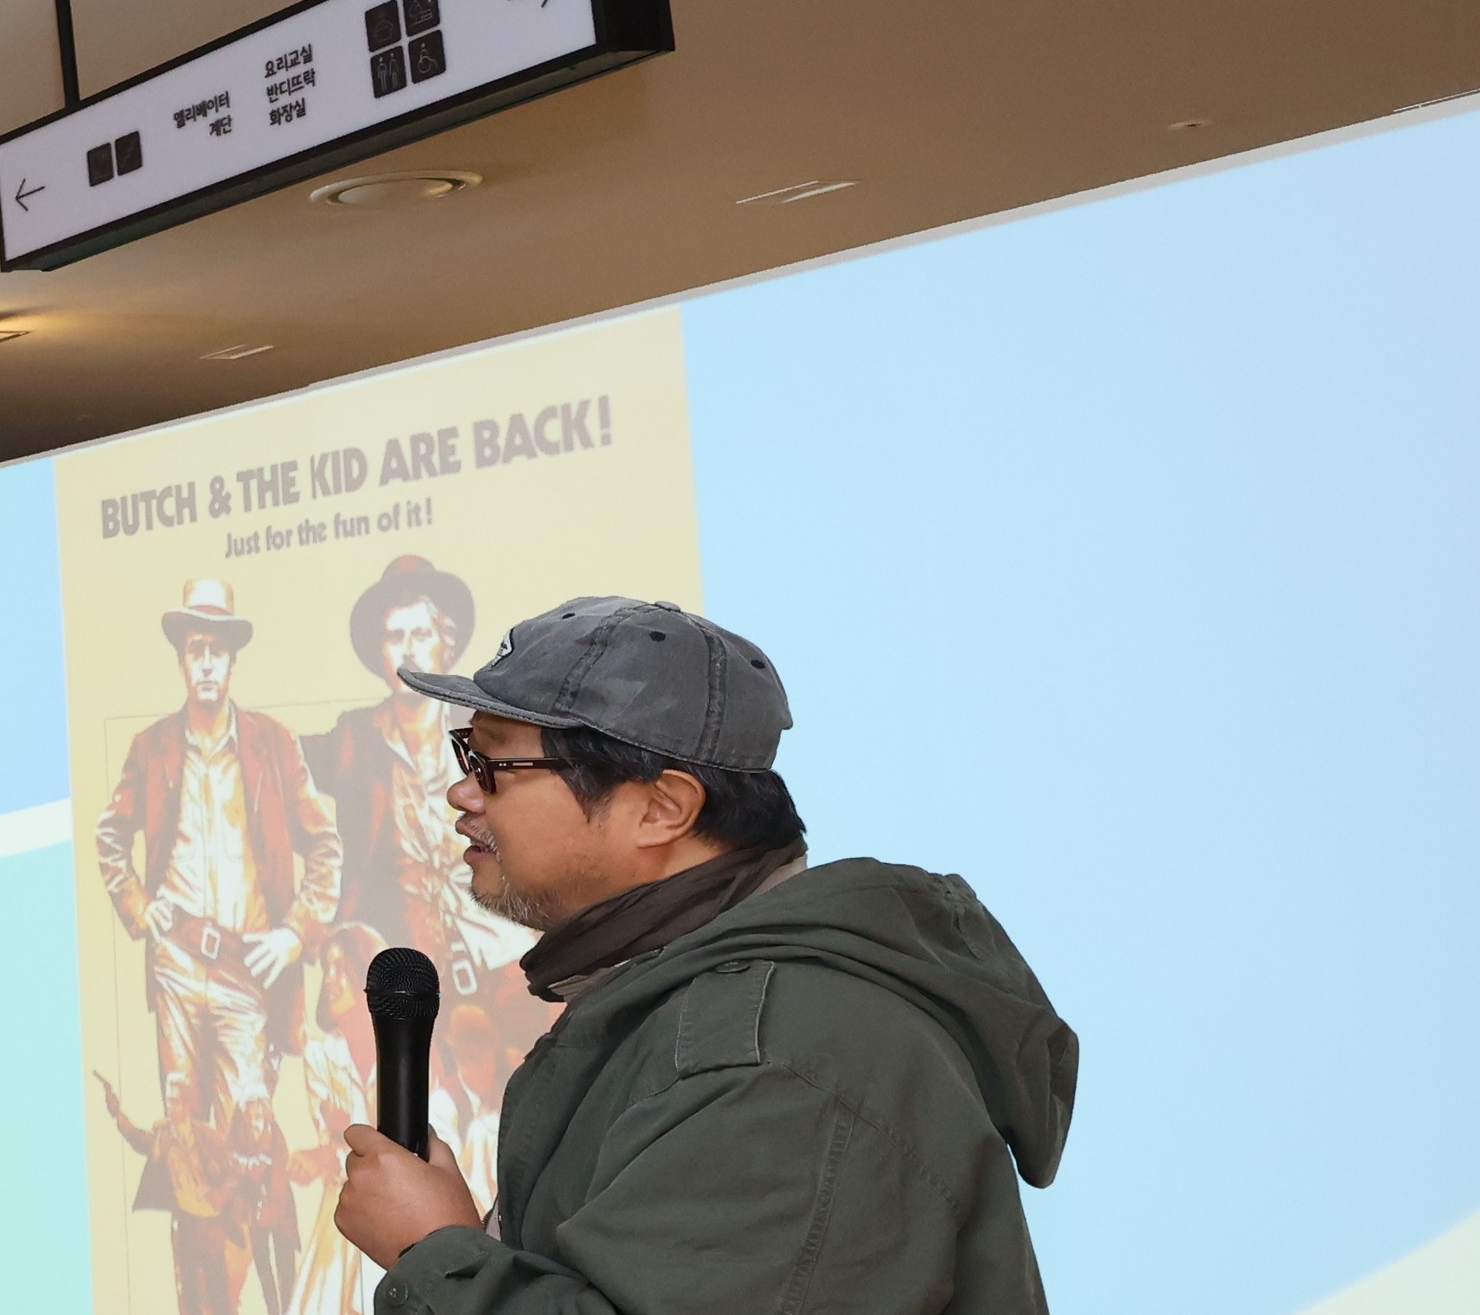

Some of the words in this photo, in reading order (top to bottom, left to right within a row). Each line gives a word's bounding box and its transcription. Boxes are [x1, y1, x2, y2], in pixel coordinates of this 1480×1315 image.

[264, 44, 314, 78] 요리교실
[266, 68, 316, 103] 반디뜨락
[173, 91, 231, 128] 엘리베이터
[209, 114, 232, 136] 계단
[269, 97, 307, 126] 화장실
[101, 481, 198, 540] BUTCH
[208, 475, 232, 519] &
[236, 459, 301, 513] THE
[310, 447, 369, 500] KID
[379, 426, 462, 487] ARE
[472, 394, 613, 470] BACK!
[224, 530, 261, 560] Just
[265, 524, 293, 553] for
[296, 518, 328, 547] the
[333, 512, 371, 541] fun
[377, 502, 401, 533] of
[406, 496, 434, 529] it!
